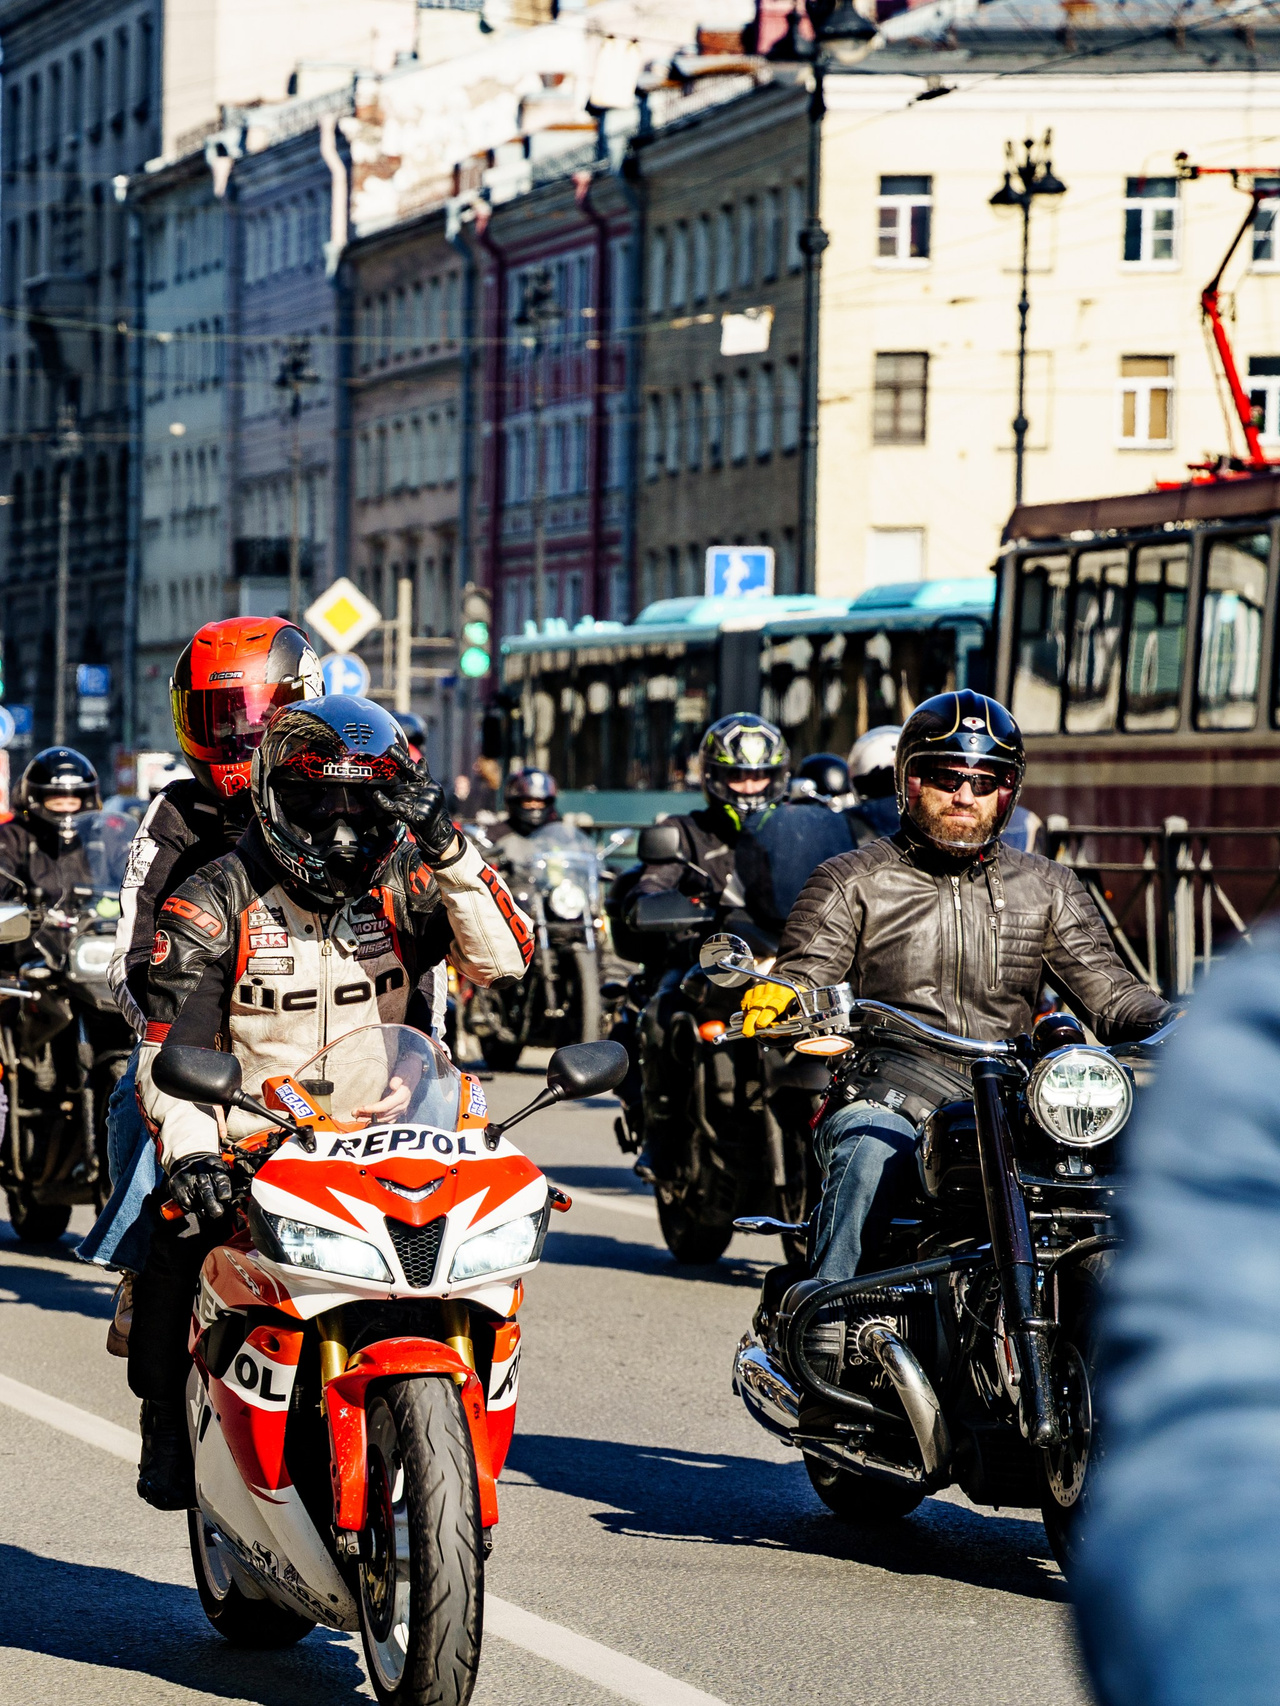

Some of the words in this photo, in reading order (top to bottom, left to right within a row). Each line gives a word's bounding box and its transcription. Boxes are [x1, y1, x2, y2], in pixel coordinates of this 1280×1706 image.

[209, 671, 244, 681] icon
[323, 761, 373, 777] icon
[161, 897, 222, 938] con
[250, 933, 286, 946] RK
[239, 966, 404, 1012] icon
[281, 1093, 314, 1117] GAS
[327, 1129, 477, 1159] REPSOL
